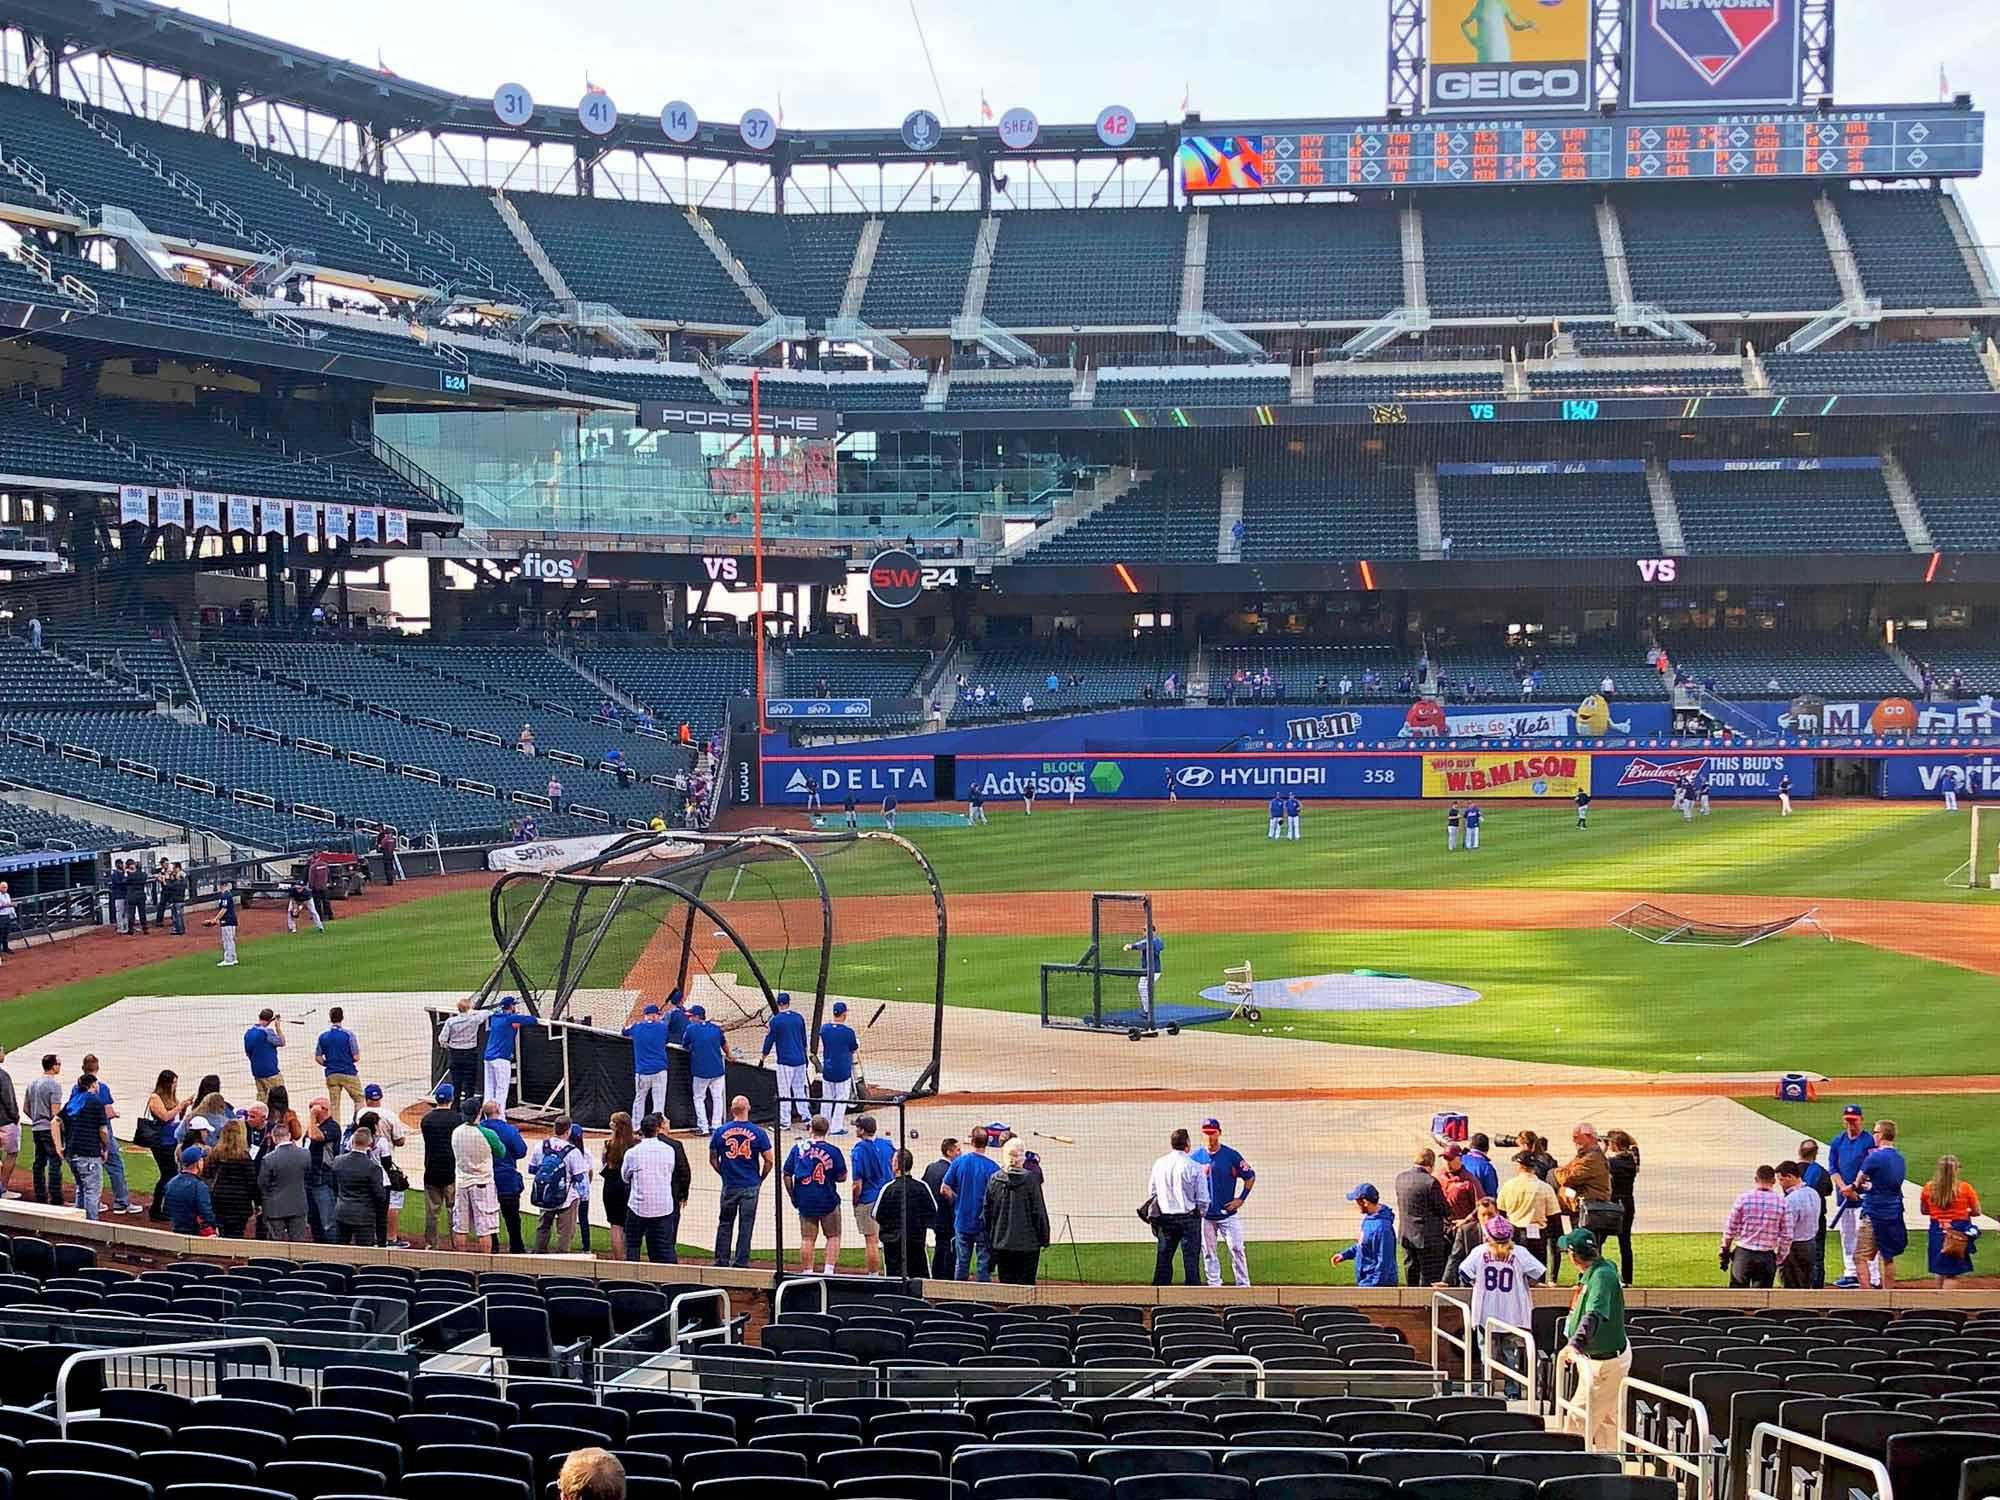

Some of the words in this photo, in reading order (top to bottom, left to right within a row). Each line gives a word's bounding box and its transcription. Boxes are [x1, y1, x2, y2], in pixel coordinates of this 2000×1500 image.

[1436, 69, 1580, 99] GEICO
[503, 94, 524, 114] 31
[588, 101, 608, 124] 41
[671, 110, 688, 131] 14
[1003, 119, 1033, 135] SHEA
[1102, 115, 1128, 135] 42
[1355, 122, 1446, 133] AMERICAN
[1456, 121, 1523, 131] LEAGUE
[1717, 114, 1805, 124] NATIONAL
[1816, 112, 1887, 122] LEAGUE
[748, 119, 768, 140] 37
[445, 375, 466, 391] 5:24
[663, 408, 818, 431] PORSCHE
[1470, 404, 1496, 420] VS
[1492, 463, 1514, 475] BUD
[1515, 462, 1549, 475] LIGHT
[1724, 461, 1748, 471] BUD
[1749, 460, 1783, 471] LIGHT
[523, 552, 574, 577] fios
[703, 557, 738, 580] VS
[1636, 559, 1676, 582] VS
[1043, 761, 1087, 774] BLOCK
[1710, 756, 1739, 770] THIS
[1743, 756, 1785, 770] BUD'S
[822, 768, 928, 790] DELTA
[982, 771, 1086, 795] Advisors
[1218, 767, 1326, 785] HYUNDAI
[1364, 769, 1397, 784] 358
[1709, 773, 1735, 787] FOR
[1739, 773, 1770, 787] YOU.
[725, 1138, 753, 1160] 34
[1484, 1265, 1513, 1292] 80
